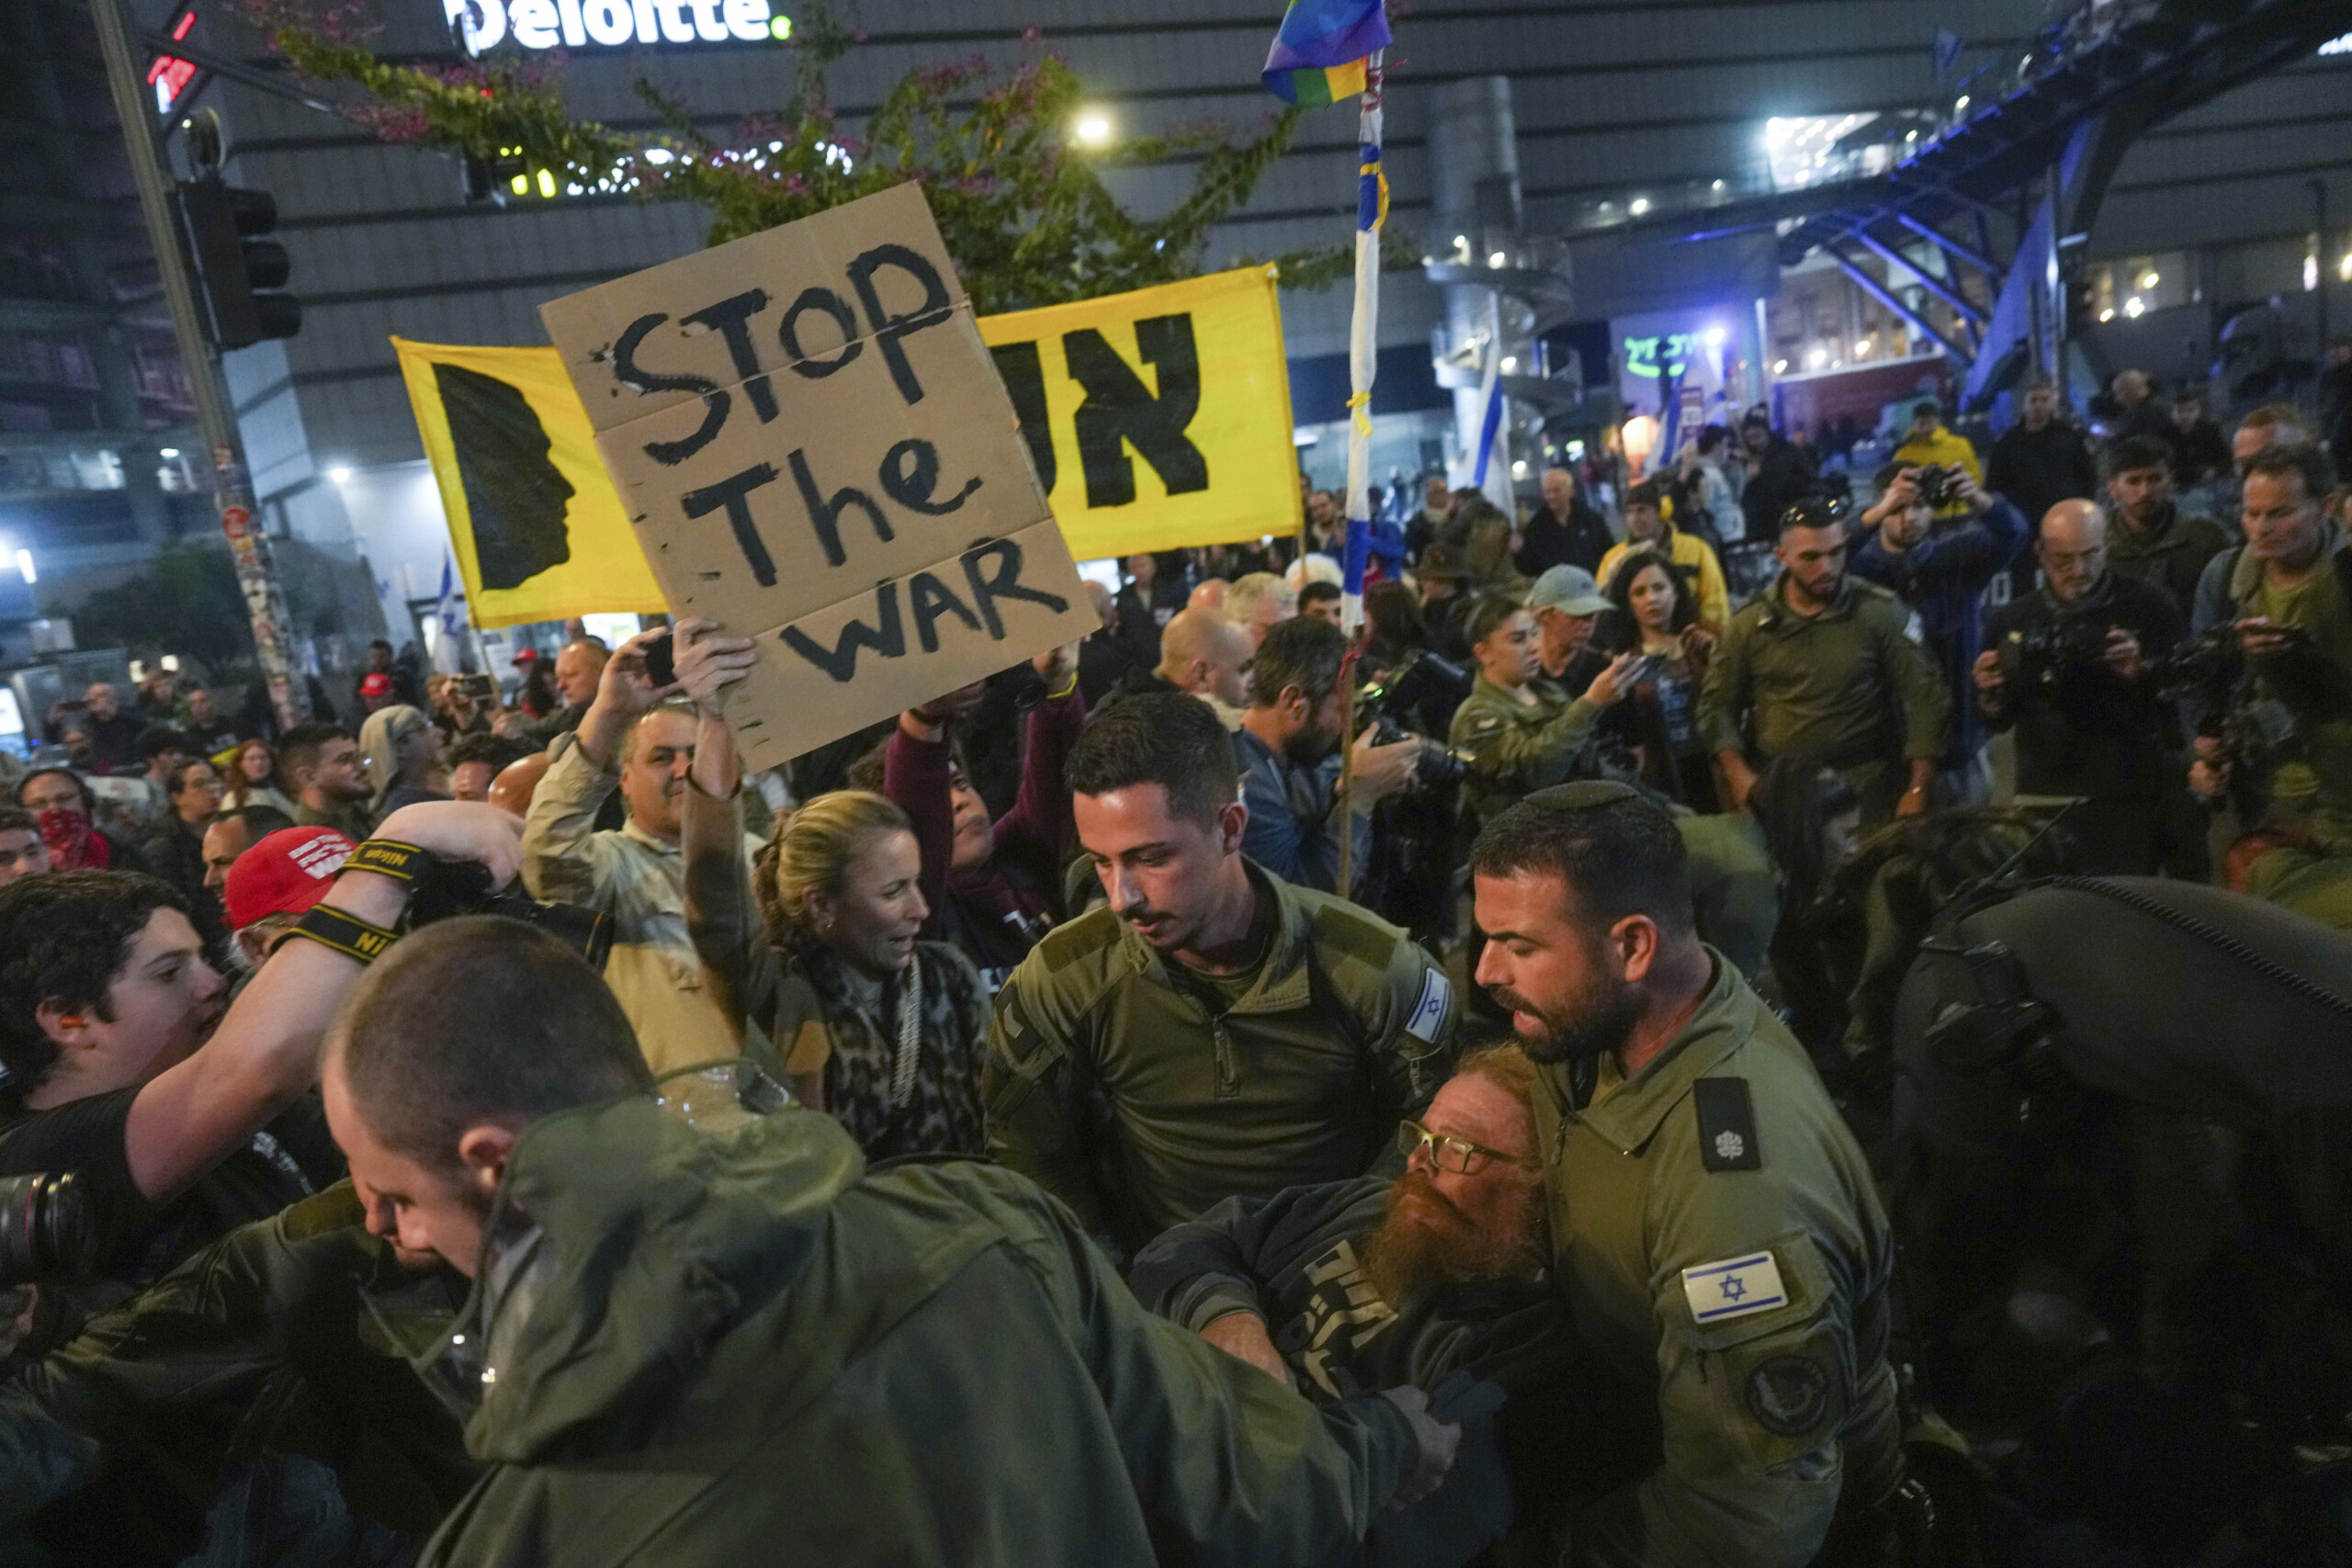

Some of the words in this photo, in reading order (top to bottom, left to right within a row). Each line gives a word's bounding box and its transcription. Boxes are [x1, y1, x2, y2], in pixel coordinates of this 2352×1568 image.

[614, 243, 953, 466] STOP
[681, 438, 983, 587] The
[779, 536, 1069, 682] WAR
[364, 849, 409, 866] Nikon
